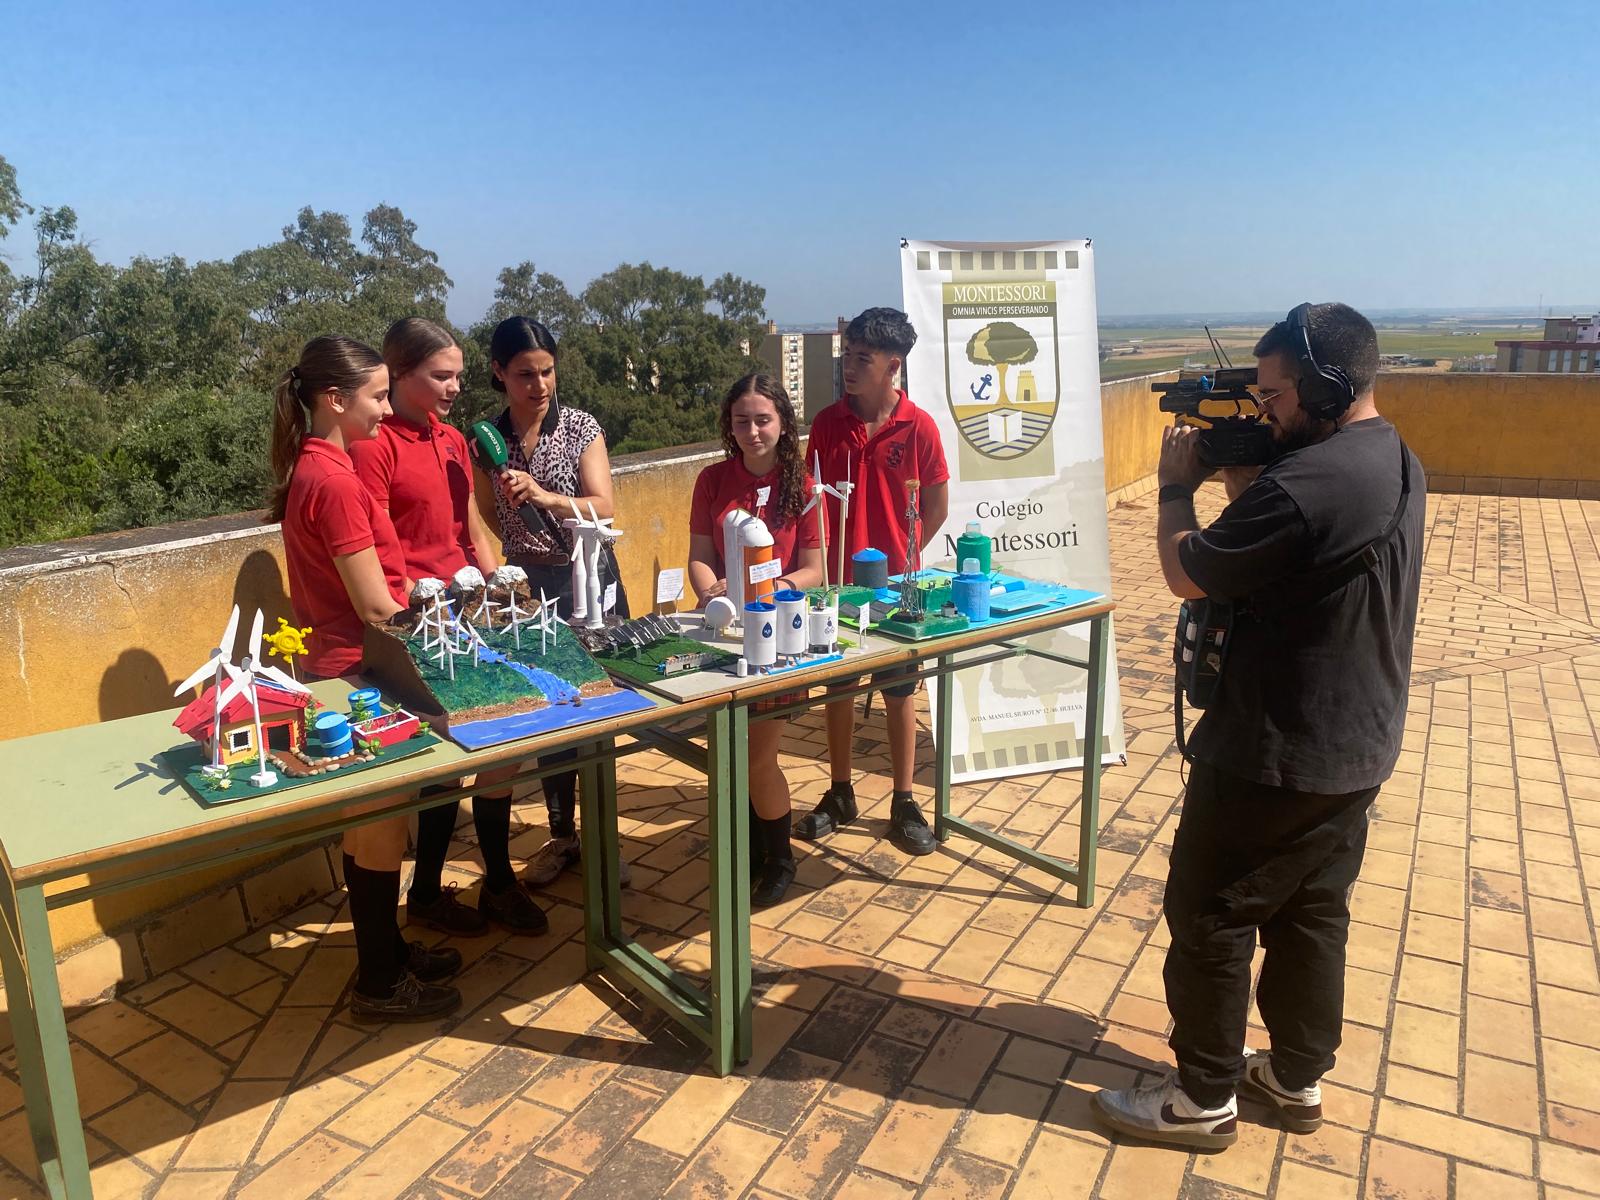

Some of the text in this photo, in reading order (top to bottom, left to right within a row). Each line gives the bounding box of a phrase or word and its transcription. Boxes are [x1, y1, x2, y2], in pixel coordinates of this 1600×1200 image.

[953, 285, 1046, 302] MONTESSORI
[952, 305, 1049, 316] OMNIA VINCIS PERSEVERANDO
[976, 498, 1043, 521] Colegio
[944, 523, 1079, 557] Mntessori
[988, 712, 1013, 721] MANUEL
